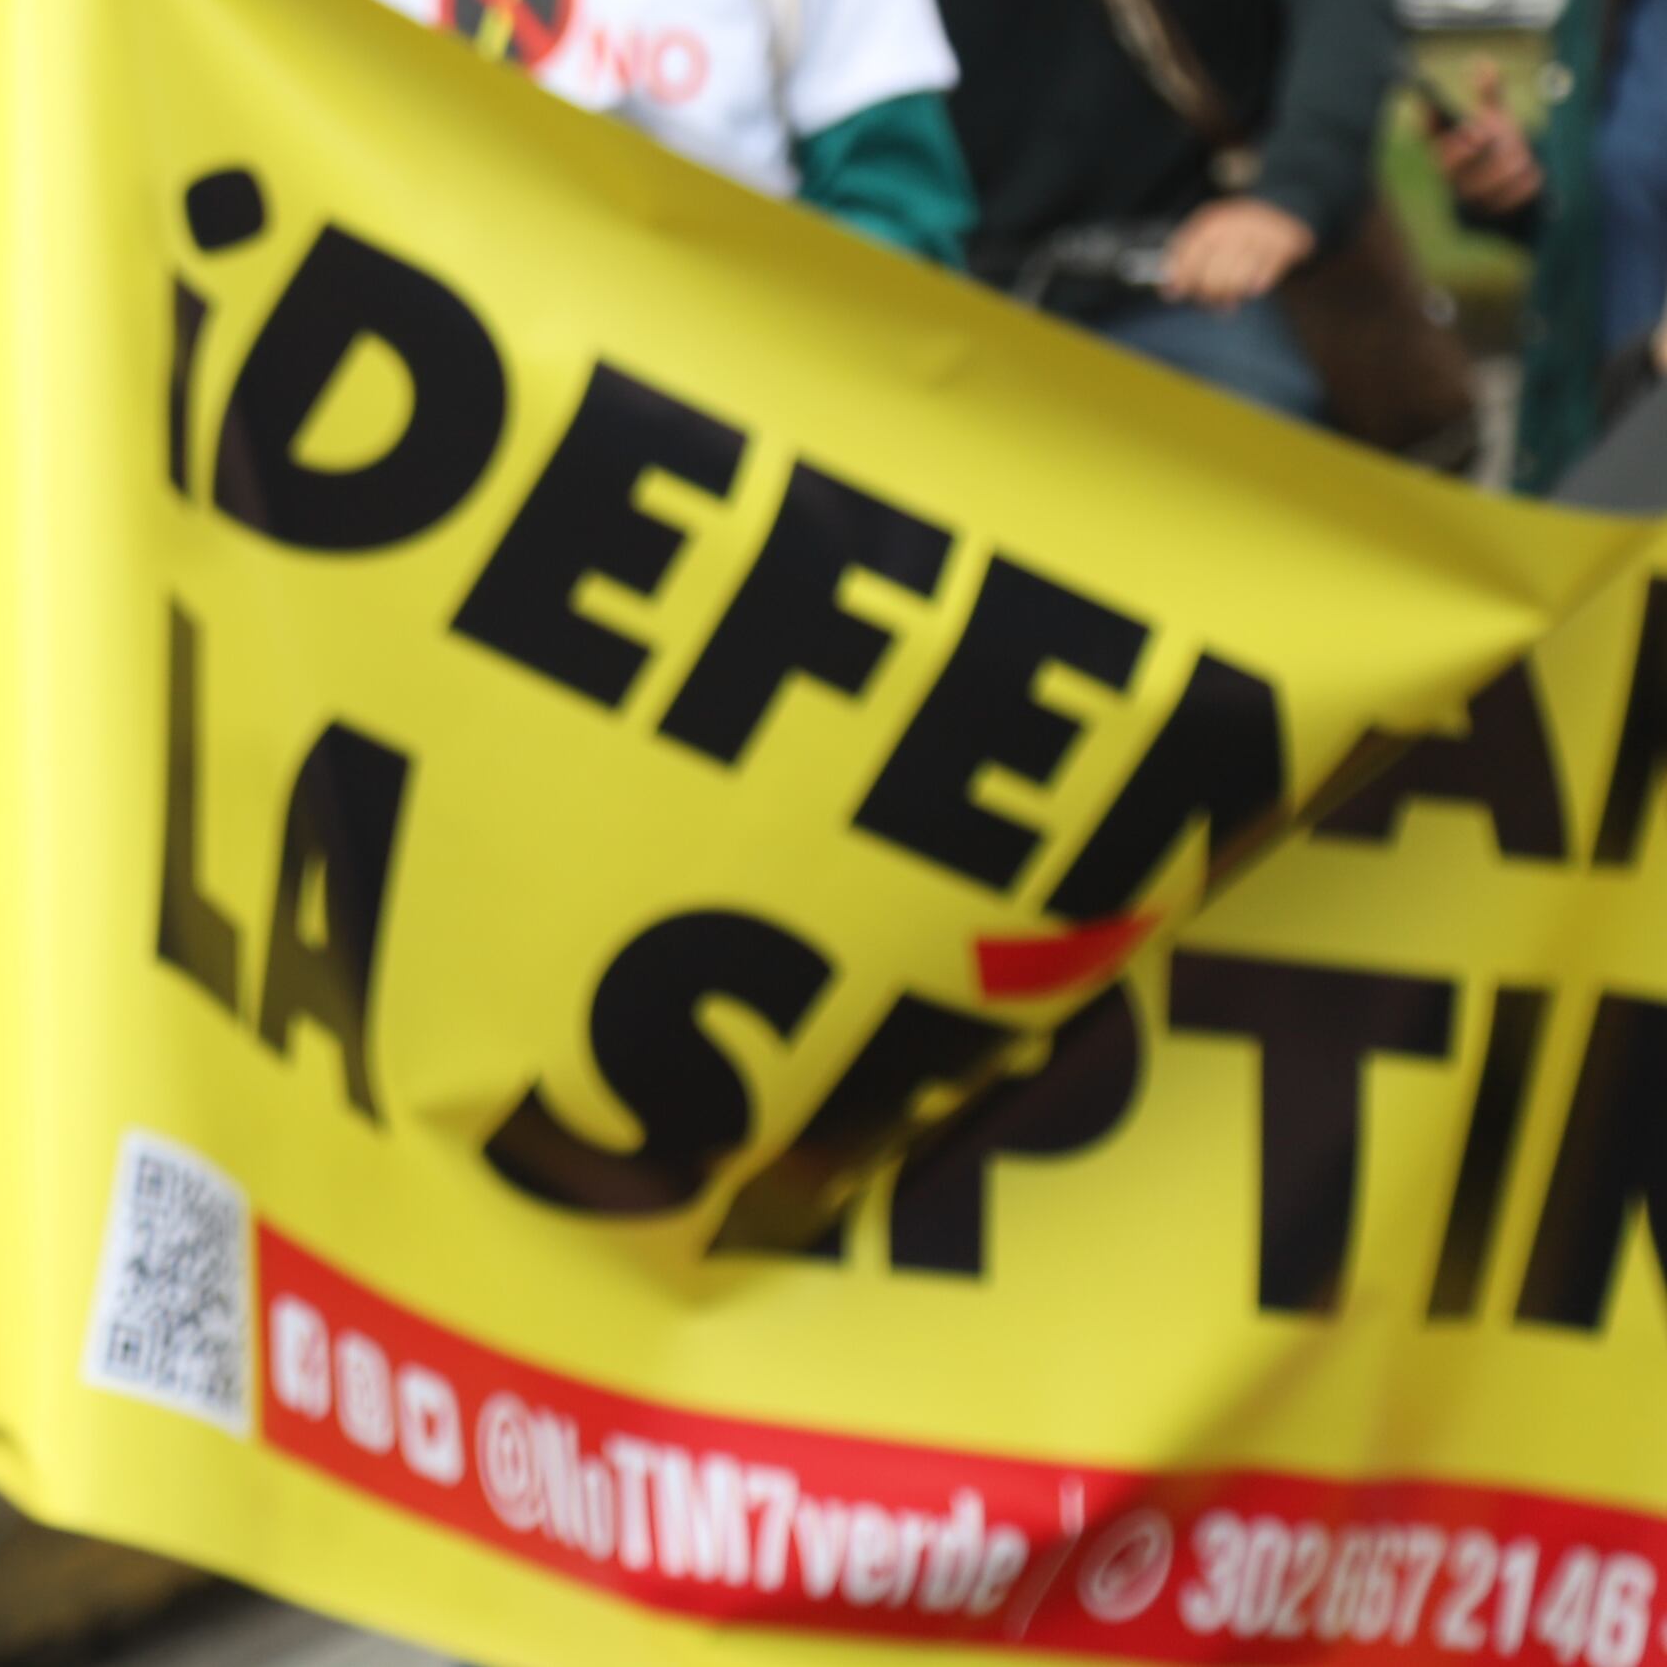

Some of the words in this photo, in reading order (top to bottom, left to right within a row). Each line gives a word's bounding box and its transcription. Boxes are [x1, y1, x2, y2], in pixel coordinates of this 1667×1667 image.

[583, 24, 712, 106] NO
[157, 594, 413, 1132] LA
[475, 1392, 1029, 1617] @NoTM7verde
